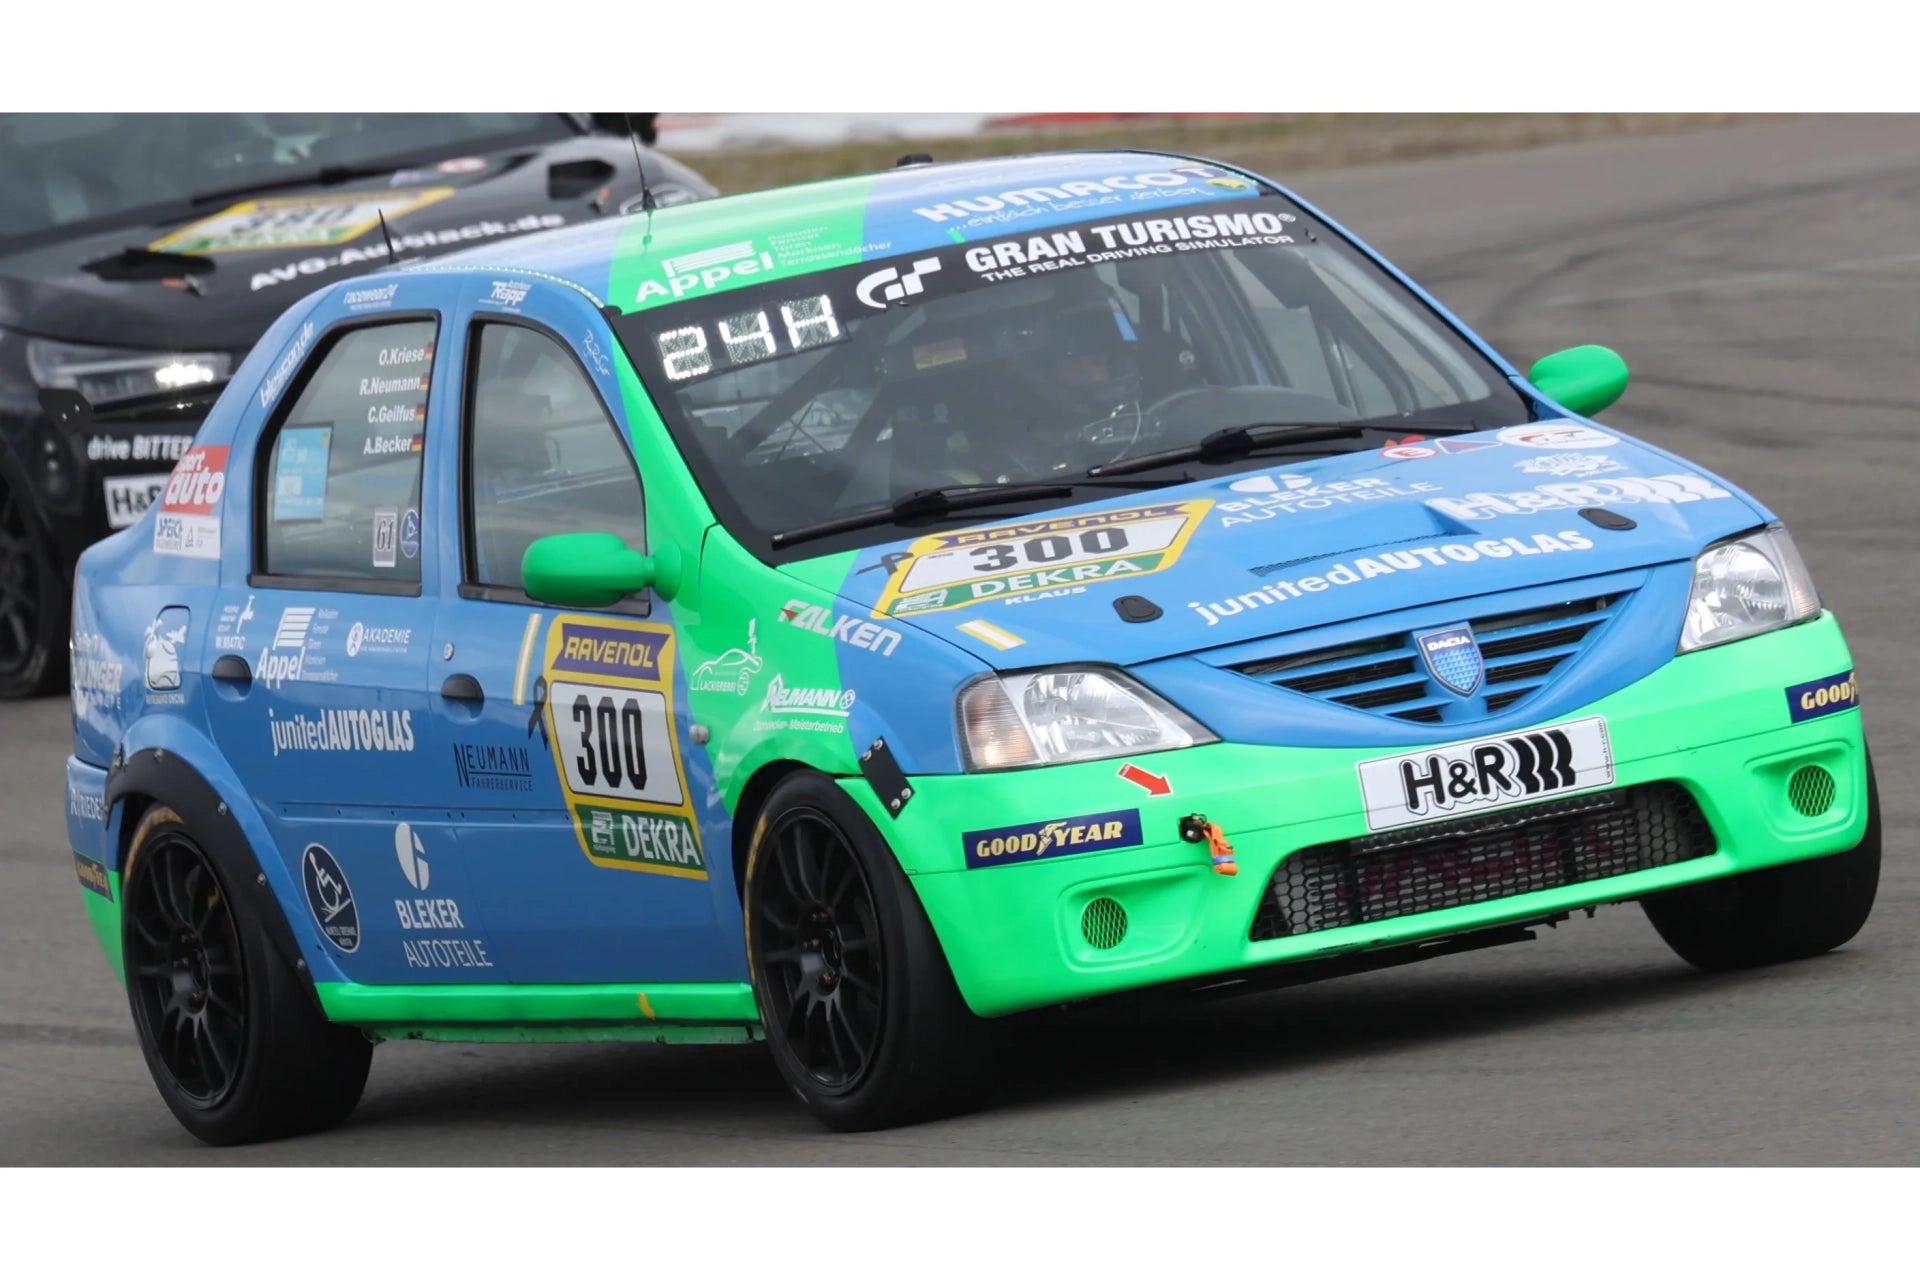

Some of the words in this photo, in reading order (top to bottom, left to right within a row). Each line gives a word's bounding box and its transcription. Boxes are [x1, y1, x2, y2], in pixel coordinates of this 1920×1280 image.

[965, 230, 1087, 273] GRAN
[981, 267, 1026, 283] THE
[1027, 256, 1085, 274] REAL
[1087, 244, 1173, 264] DRIVING
[1174, 235, 1295, 252] SIMULATOR
[635, 252, 775, 304] Appel
[378, 346, 424, 366] O.Kriese
[359, 377, 420, 396] R.Neumann
[87, 434, 131, 460] drive
[363, 435, 412, 455] A.Becker
[164, 467, 225, 505] auto
[1216, 477, 1391, 512] BLEKER
[1221, 481, 1444, 528] AUTOTEILE
[956, 505, 1167, 543] RAVENOL
[970, 527, 1129, 572] 300
[971, 559, 1143, 599] DEKRA
[1004, 586, 1087, 605] KLAUS
[1187, 530, 1594, 626] junitedAUTOGLAS
[363, 628, 411, 644] AKADEMIE
[777, 599, 902, 656] FALKEN
[1427, 635, 1471, 651] DACIA
[255, 647, 306, 690] Appel
[564, 636, 653, 668] RAVENOL
[268, 708, 415, 757] junitedAUTOGLAS
[572, 694, 647, 790] 300
[453, 743, 530, 788] NEUMANN
[1402, 745, 1512, 811] H&R
[621, 814, 701, 866] DEKRA
[976, 821, 1123, 857] GOODYEAR
[394, 899, 465, 930] BLEKER
[402, 940, 494, 968] AUTOTEILE
